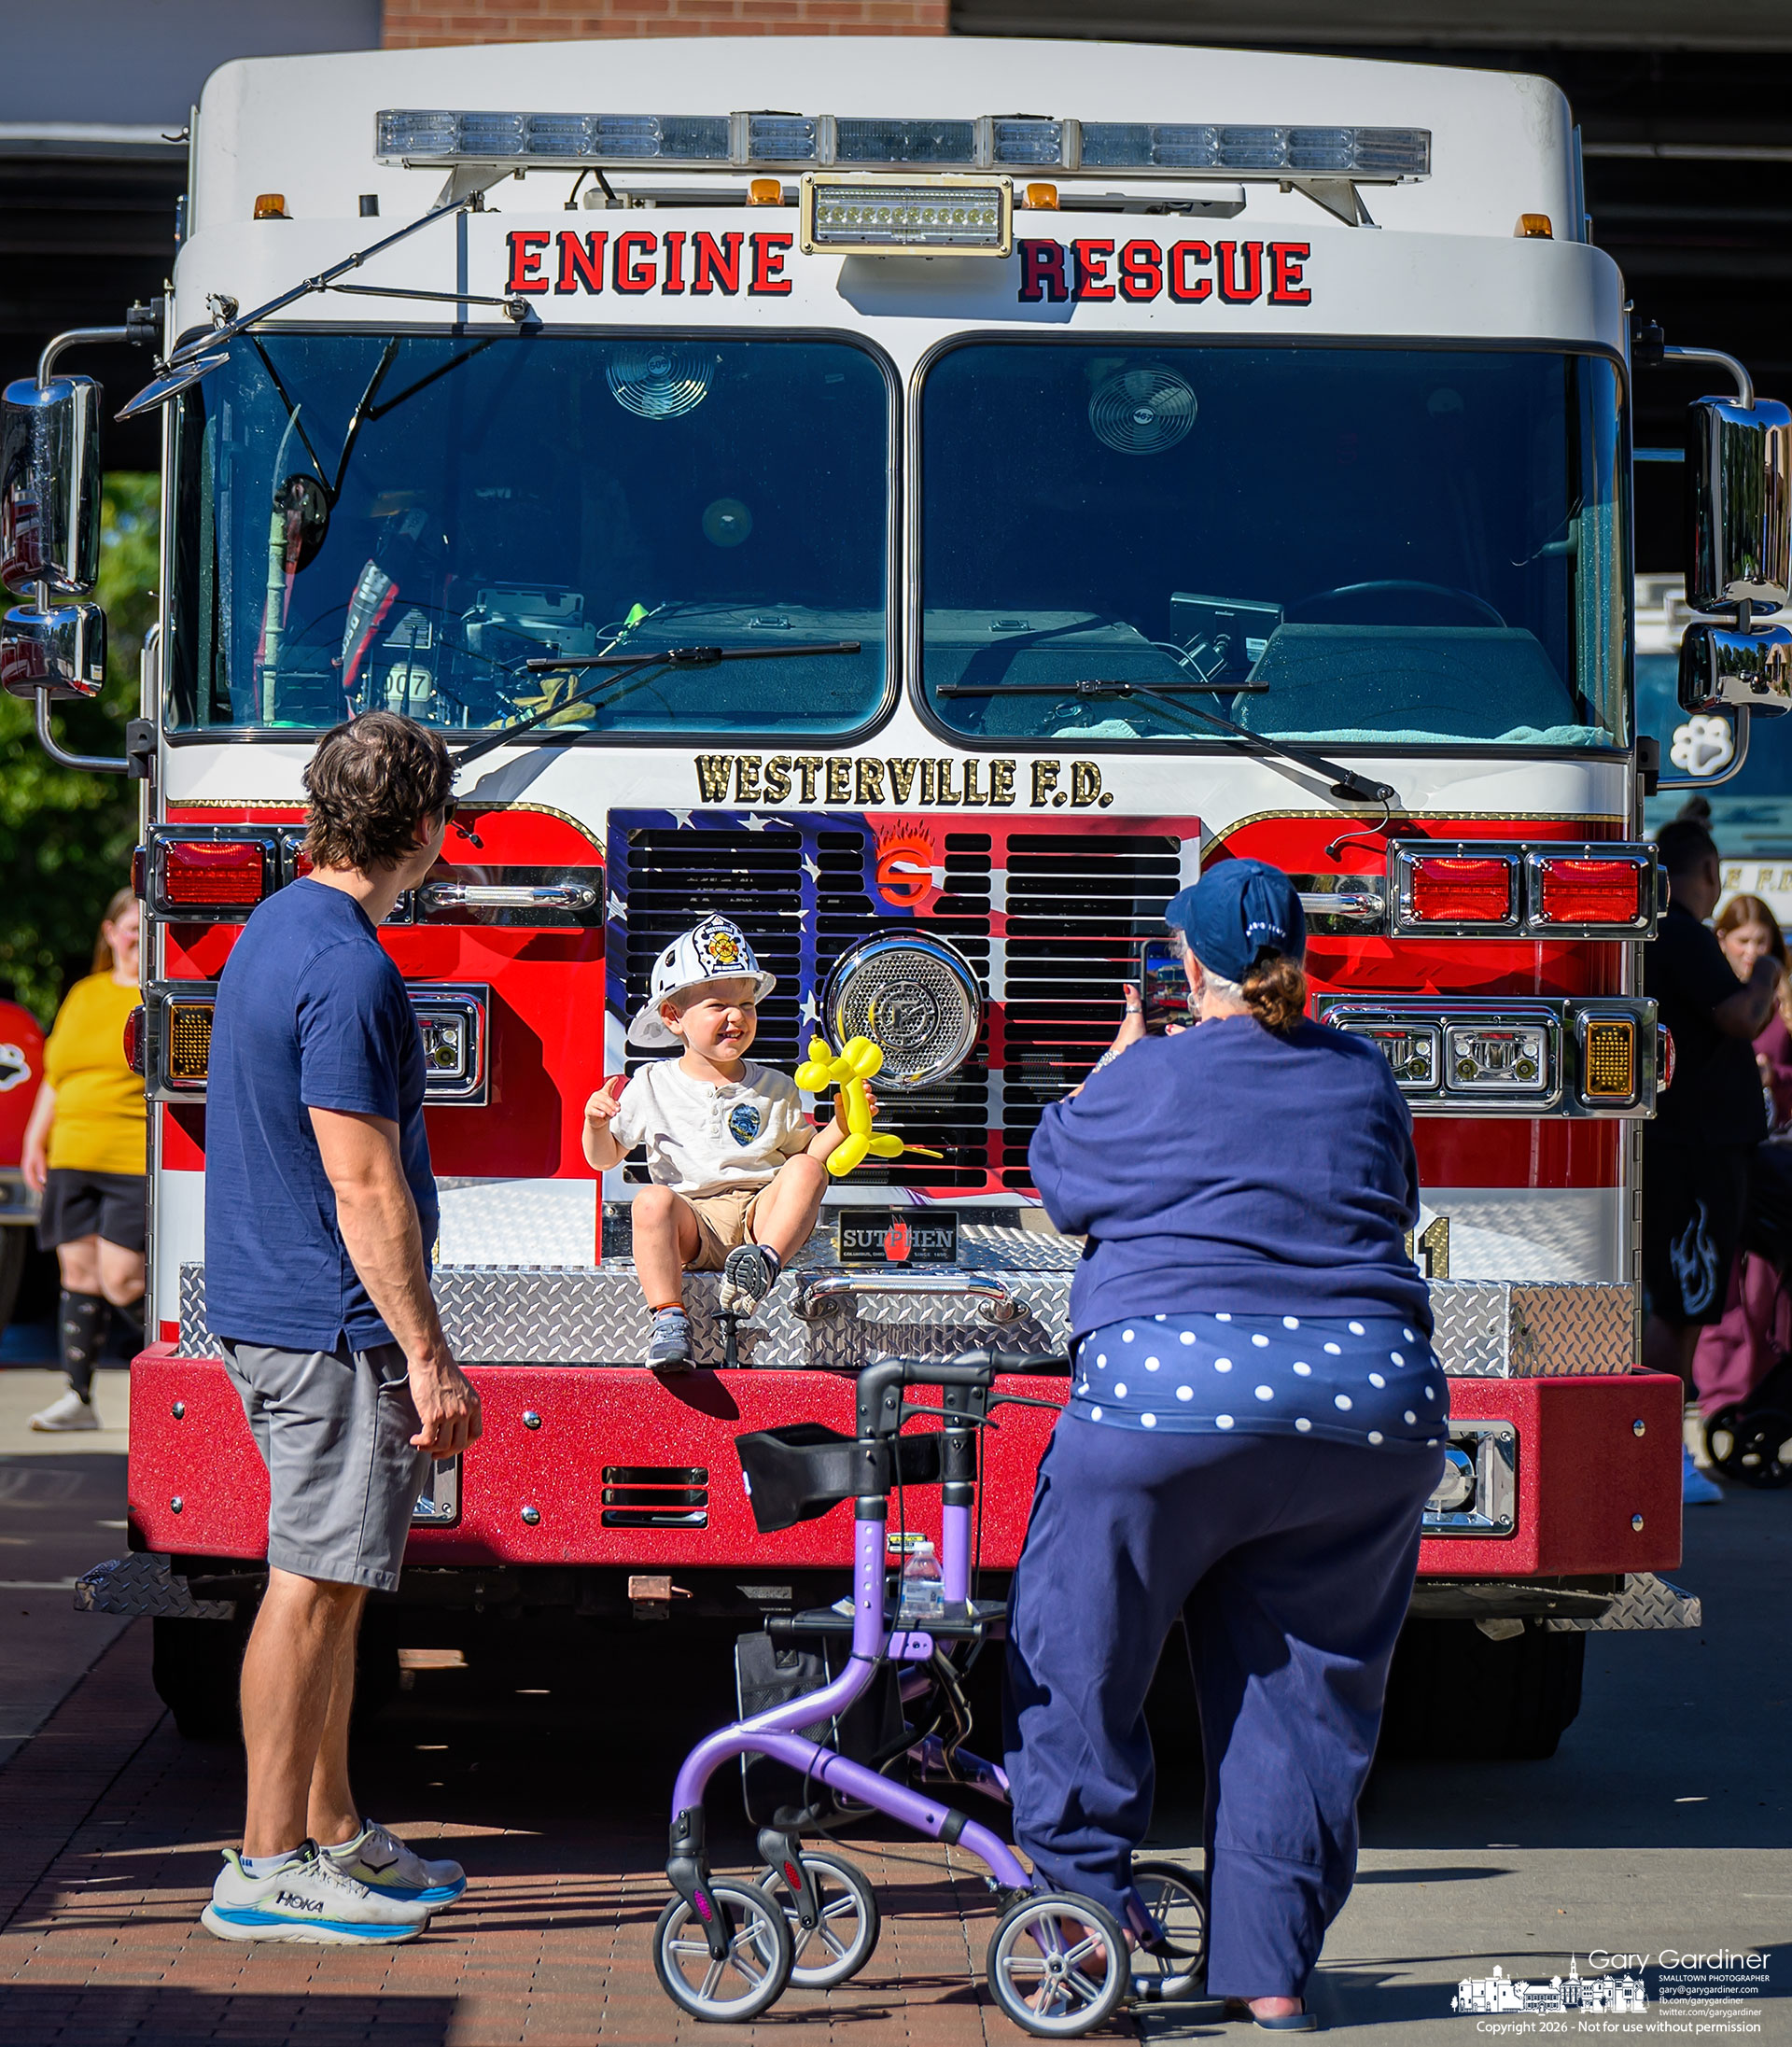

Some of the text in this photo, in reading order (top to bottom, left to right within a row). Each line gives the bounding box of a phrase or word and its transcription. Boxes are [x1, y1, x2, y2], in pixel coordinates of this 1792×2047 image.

[504, 231, 1312, 307] ENGINE RESCUE
[693, 754, 1115, 809] WESTERVILLE F.D.
[843, 1228, 954, 1248] SUTPHEN
[275, 1891, 326, 1914] HOKA
